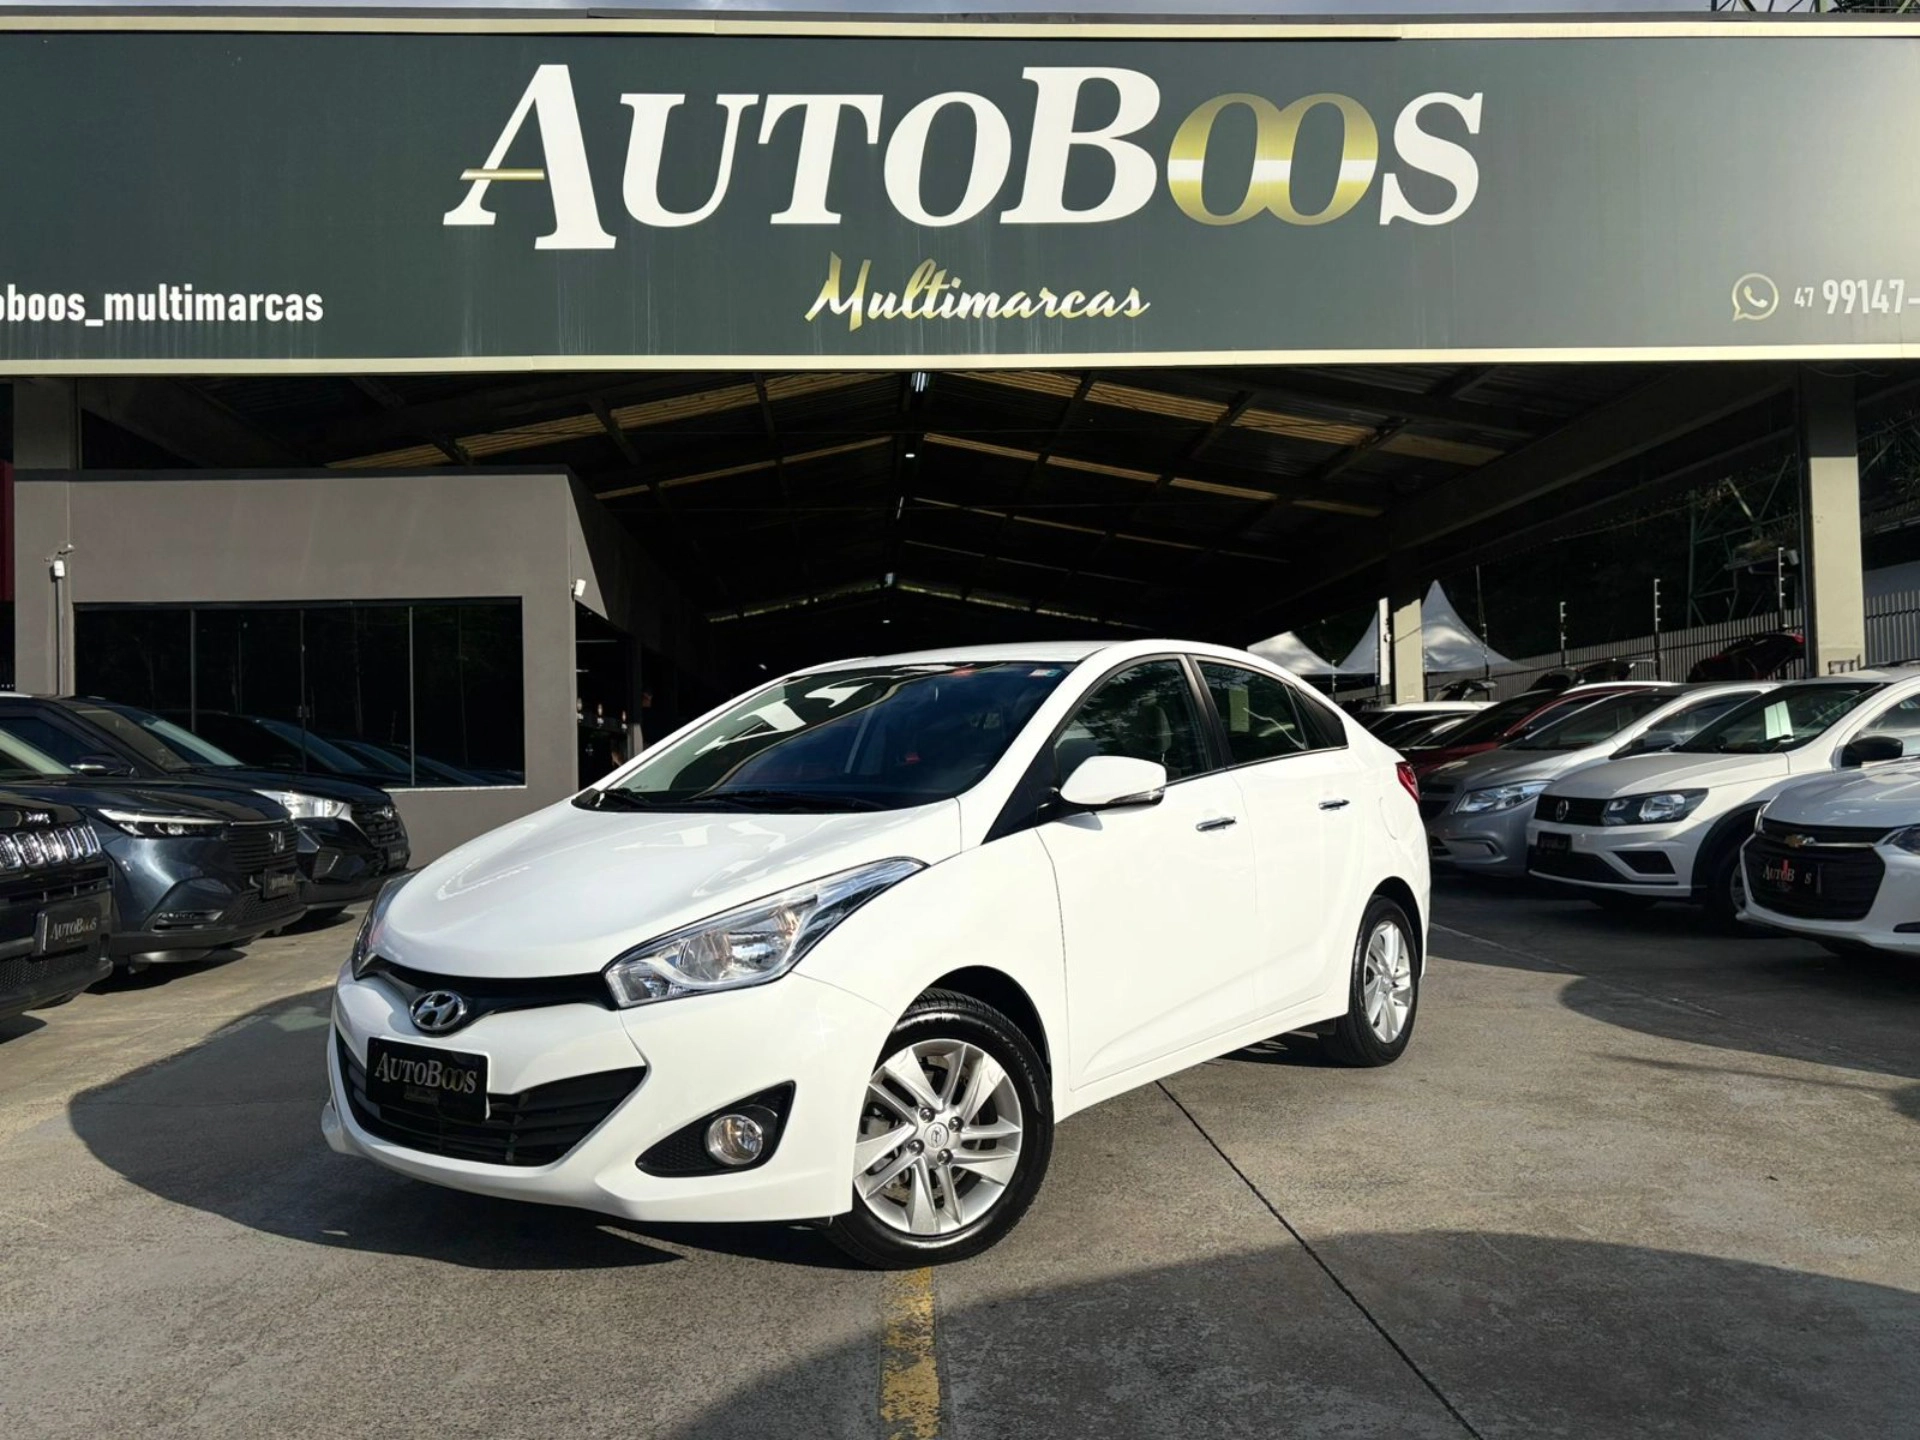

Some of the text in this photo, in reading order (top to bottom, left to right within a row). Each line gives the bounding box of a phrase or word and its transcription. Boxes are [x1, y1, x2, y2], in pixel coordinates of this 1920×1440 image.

[0, 284, 323, 327] boos_multimarcas
[805, 252, 1150, 331] Multimarcas
[1793, 287, 1815, 308] 47
[1762, 864, 1813, 885] AUTOBS
